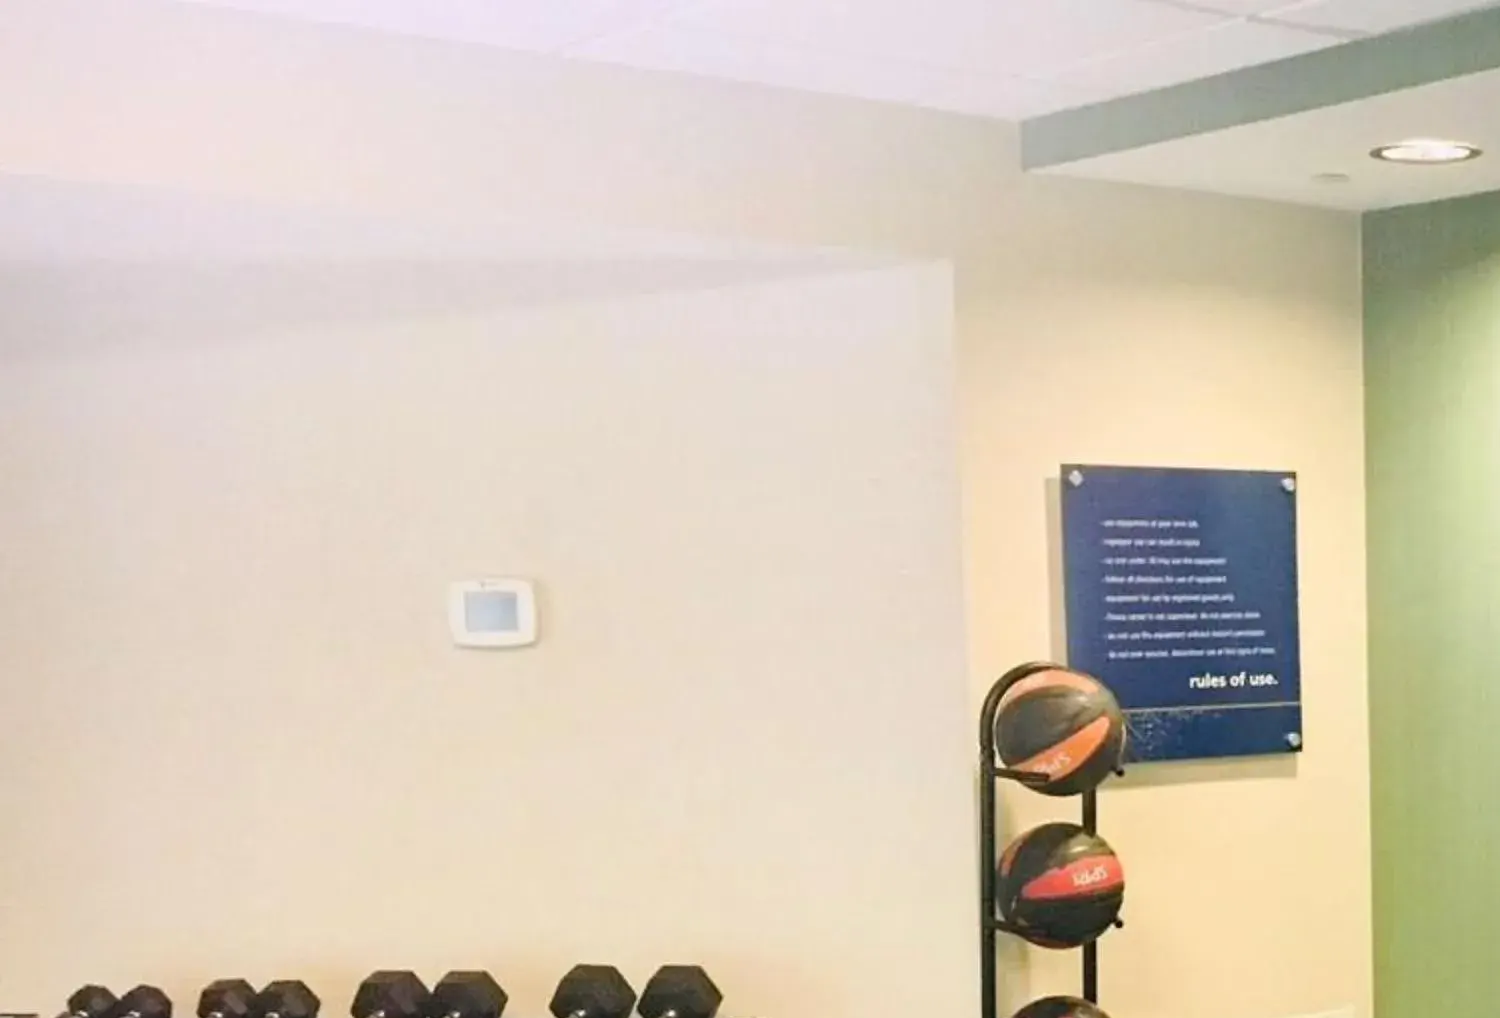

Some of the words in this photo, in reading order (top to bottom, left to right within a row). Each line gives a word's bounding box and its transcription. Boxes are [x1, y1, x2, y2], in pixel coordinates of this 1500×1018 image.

[1188, 672, 1227, 689] rules
[1229, 671, 1247, 687] of
[1249, 673, 1280, 687] use.
